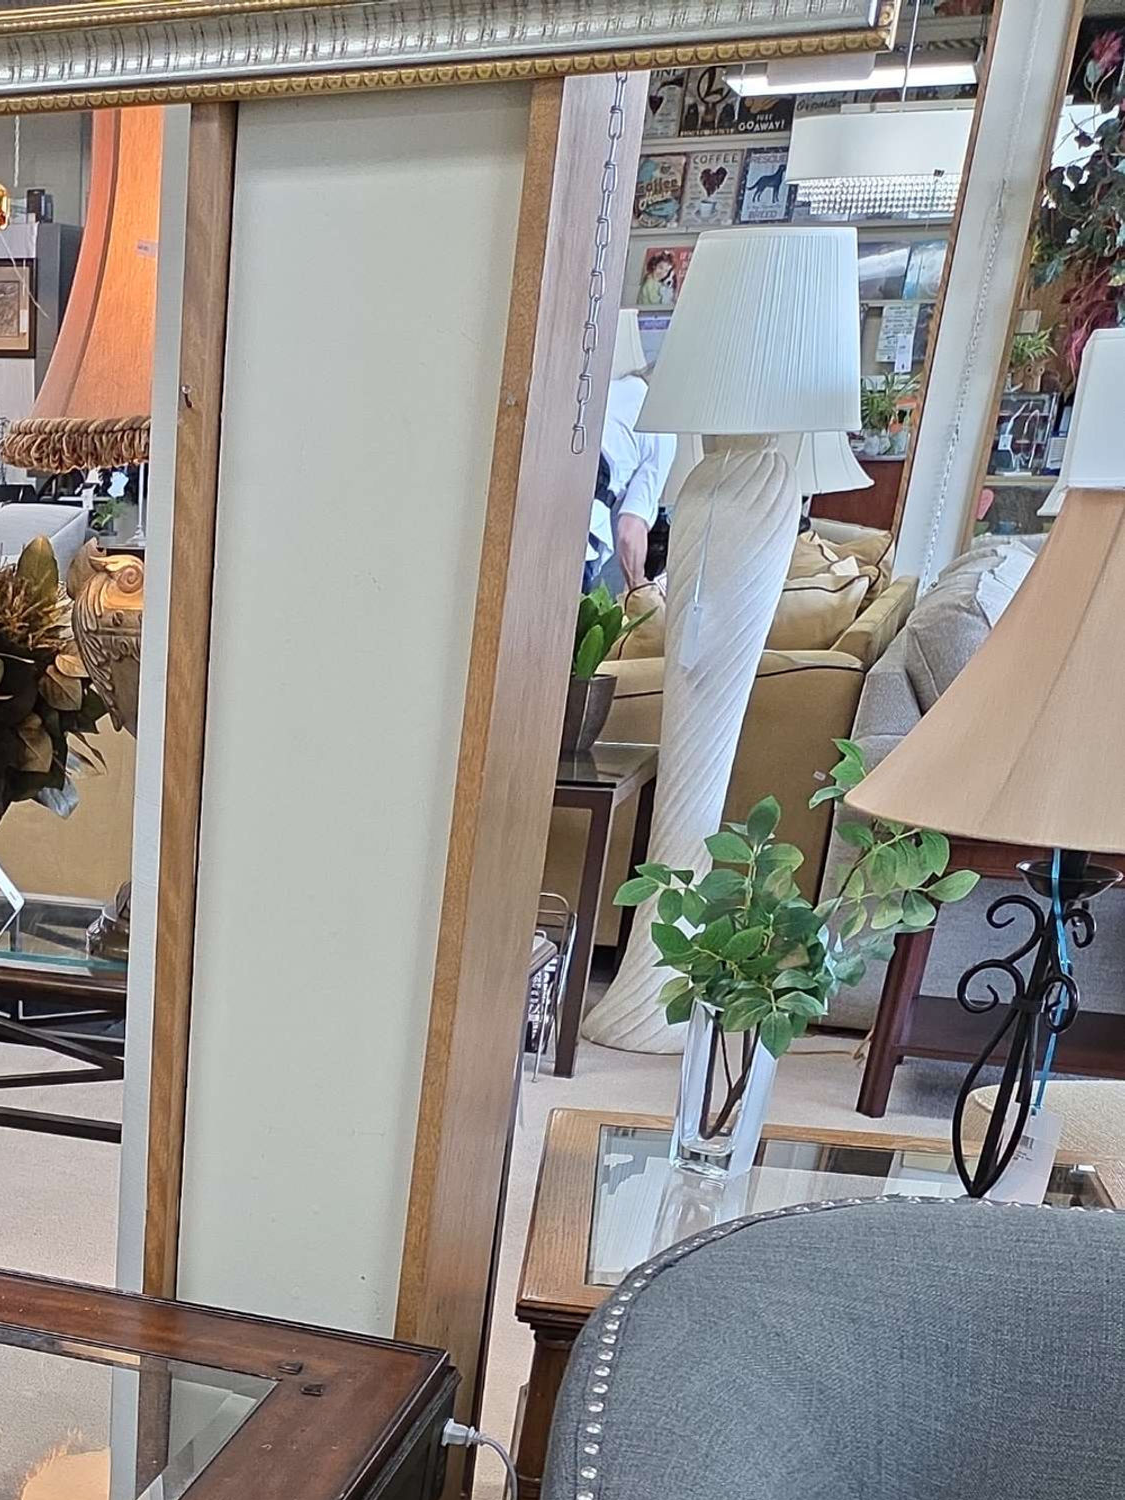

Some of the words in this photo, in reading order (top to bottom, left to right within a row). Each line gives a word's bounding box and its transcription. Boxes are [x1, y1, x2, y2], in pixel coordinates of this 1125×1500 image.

[738, 120, 755, 132] GO
[753, 119, 785, 132] AWAY!
[692, 152, 738, 165] COFFEE
